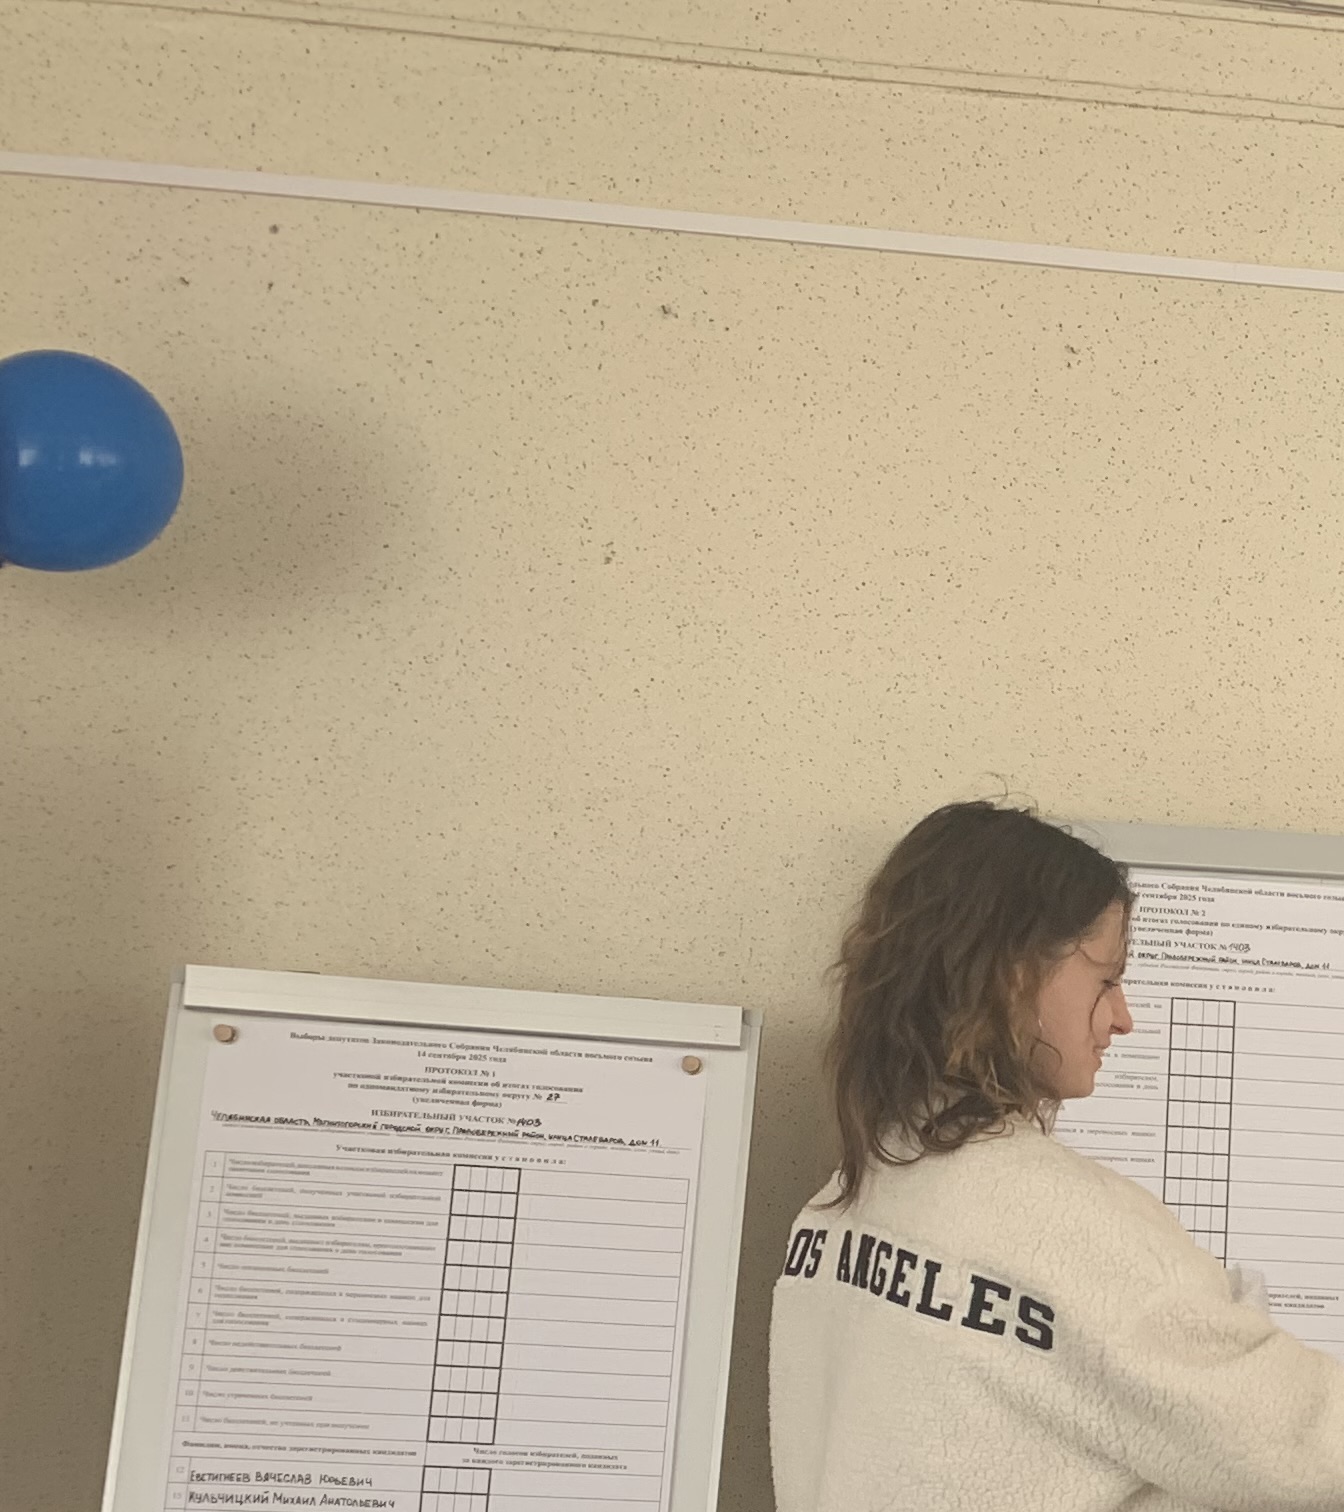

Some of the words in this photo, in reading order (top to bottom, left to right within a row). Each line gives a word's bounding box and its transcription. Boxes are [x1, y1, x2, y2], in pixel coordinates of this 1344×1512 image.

[1139, 906, 1189, 916] ПРОТОКОЛ
[424, 1066, 478, 1076] ПРОТОКОЛ
[371, 1109, 456, 1122] ИЗБИРАТЕЛЬНЫЙ
[784, 1228, 828, 1279] OS
[836, 1229, 1055, 1351] ANGELES
